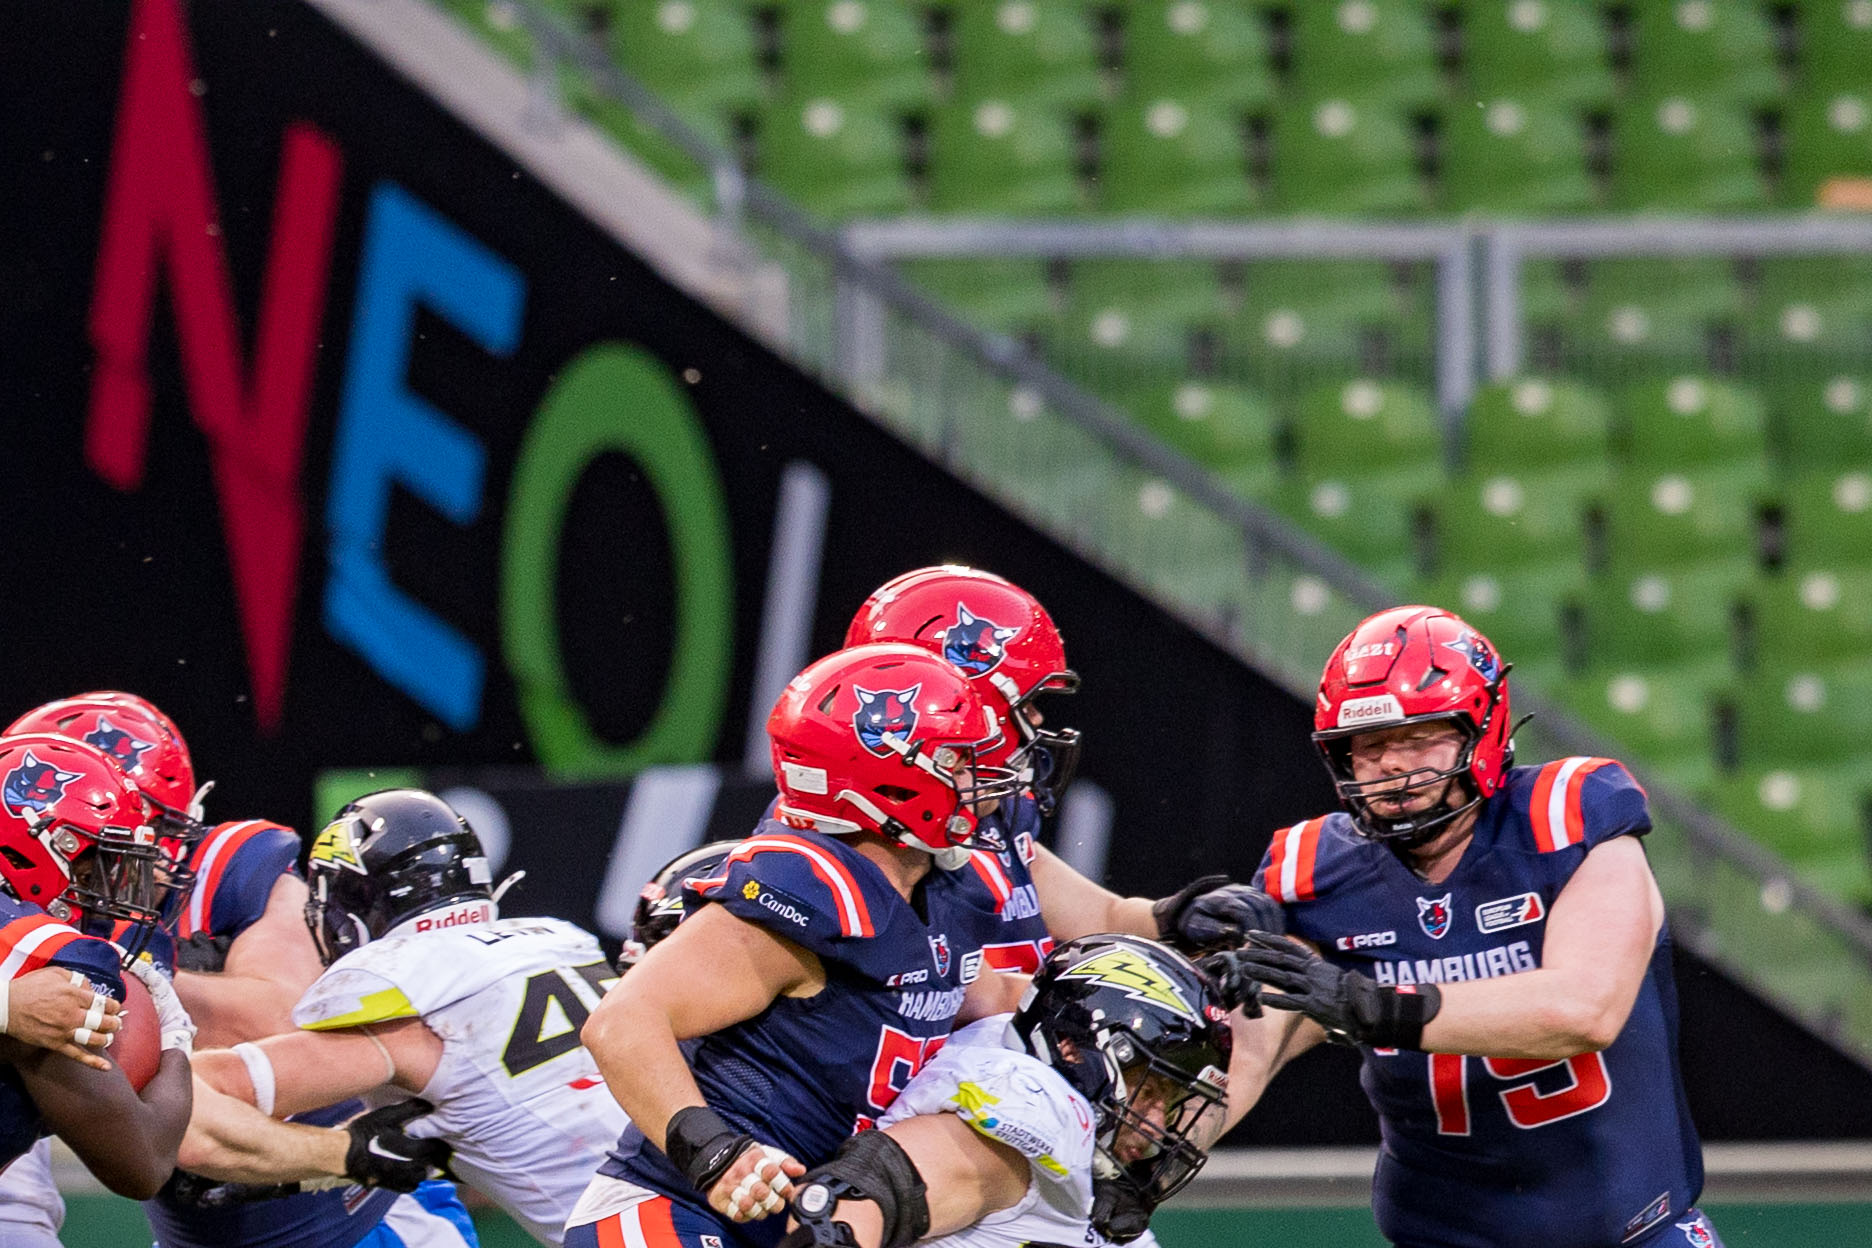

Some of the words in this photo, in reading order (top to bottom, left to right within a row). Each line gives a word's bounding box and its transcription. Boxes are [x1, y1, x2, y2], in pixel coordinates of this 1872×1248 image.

[1343, 702, 1392, 719] Riddell
[759, 892, 809, 927] CanDoc
[1374, 940, 1537, 987] HAMBURG
